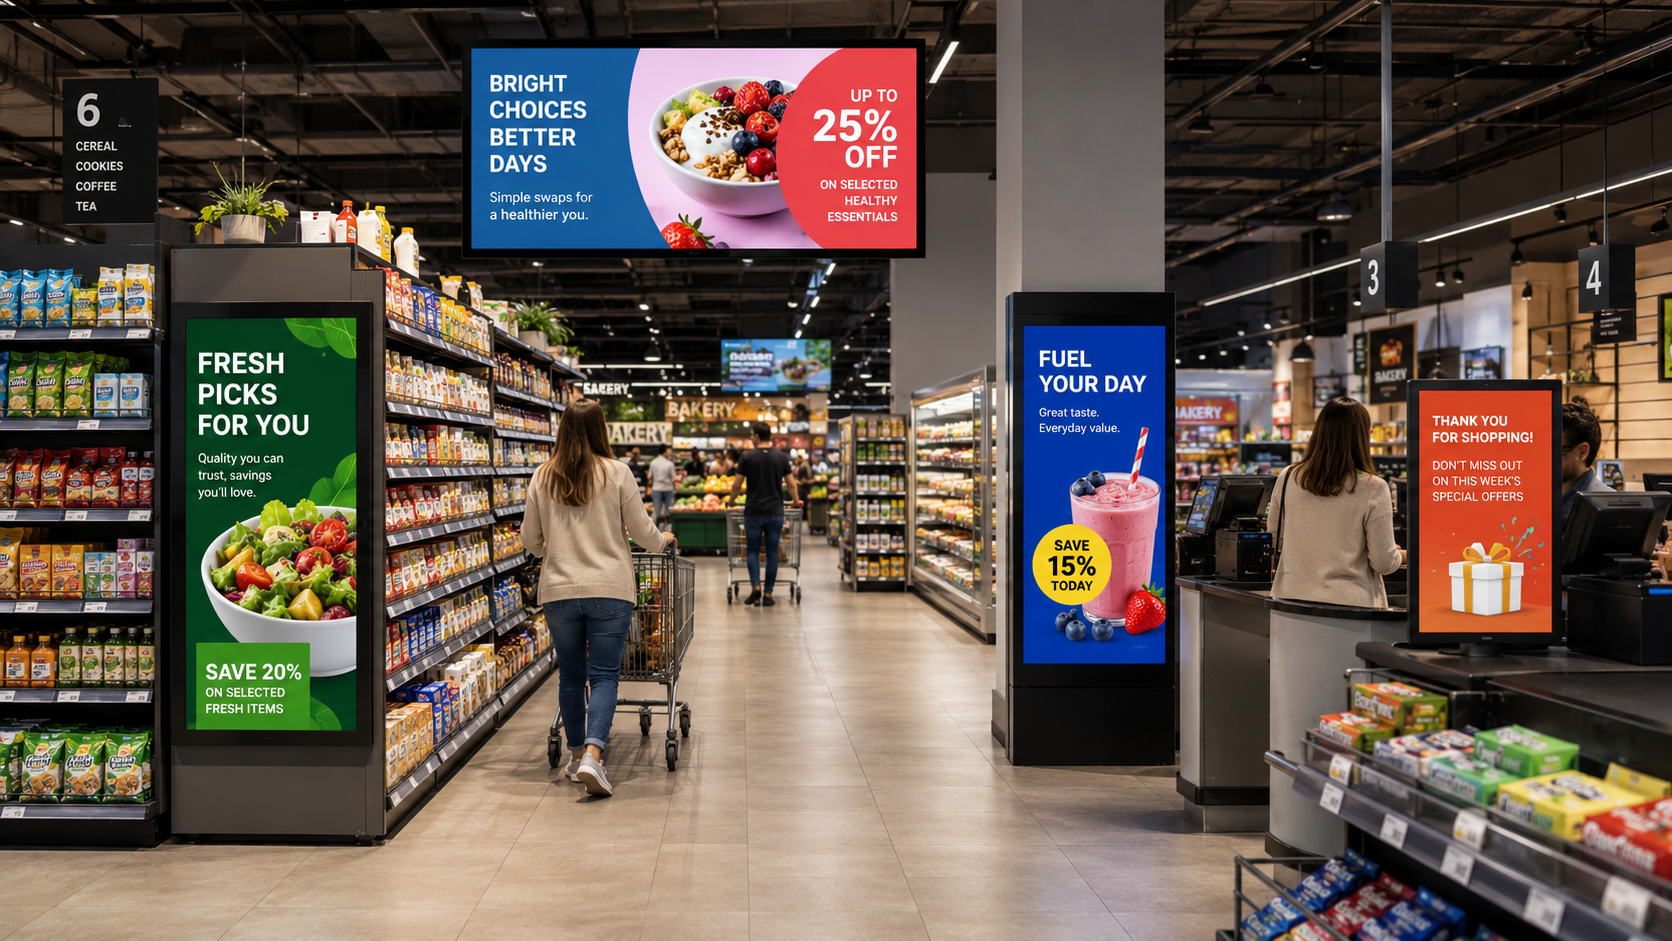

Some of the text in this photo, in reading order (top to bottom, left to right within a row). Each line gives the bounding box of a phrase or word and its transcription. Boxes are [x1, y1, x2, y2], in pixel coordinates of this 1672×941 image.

[490, 75, 567, 92] BRIGHT
[851, 89, 897, 102] UP TO
[77, 93, 100, 127] 6
[490, 101, 586, 119] CHOICES
[814, 109, 897, 142] 25%
[490, 128, 575, 146] BETTER
[76, 141, 117, 151] CEREAL
[845, 145, 897, 168] OFF
[76, 161, 123, 171] COOKIES
[490, 155, 547, 172] DAYS
[76, 182, 116, 191] COFFEE
[821, 180, 897, 189] ON SELECTED
[490, 192, 593, 205] Simple swaps for
[845, 196, 897, 205] HEALTHY
[75, 202, 97, 211] TEA
[490, 209, 588, 223] a healthier you.
[828, 212, 897, 221] ESSENTIALS
[1368, 260, 1379, 295] 3
[1586, 261, 1601, 295] 4
[199, 352, 283, 373] FRESH
[1040, 350, 1091, 367] FUEL
[1039, 375, 1146, 392] YOUR DAY
[199, 383, 277, 405] PICKS
[668, 401, 736, 418] BAKERY
[1039, 408, 1099, 417] Great taste.
[199, 414, 308, 435] FOR YOU
[1432, 416, 1507, 426] THANK YOU
[1040, 423, 1120, 435] Everyday value.
[1433, 432, 1533, 442] FOR SHOPPING!
[199, 453, 283, 465] Quality you can
[1433, 461, 1522, 470] DON'T MISS OUT
[198, 470, 271, 482] trust, savings
[1433, 476, 1520, 486] ON THIS WEEK'S
[198, 487, 255, 499] you'll love.
[1433, 492, 1523, 501] SPECIAL OFFERS
[1055, 540, 1089, 551] SAVE
[1048, 556, 1096, 576] 15%
[1051, 581, 1093, 591] TODAY
[206, 664, 301, 680] SAVE 20%
[206, 687, 285, 697] ON SELECTED
[206, 704, 283, 713] FRESH ITEMS
